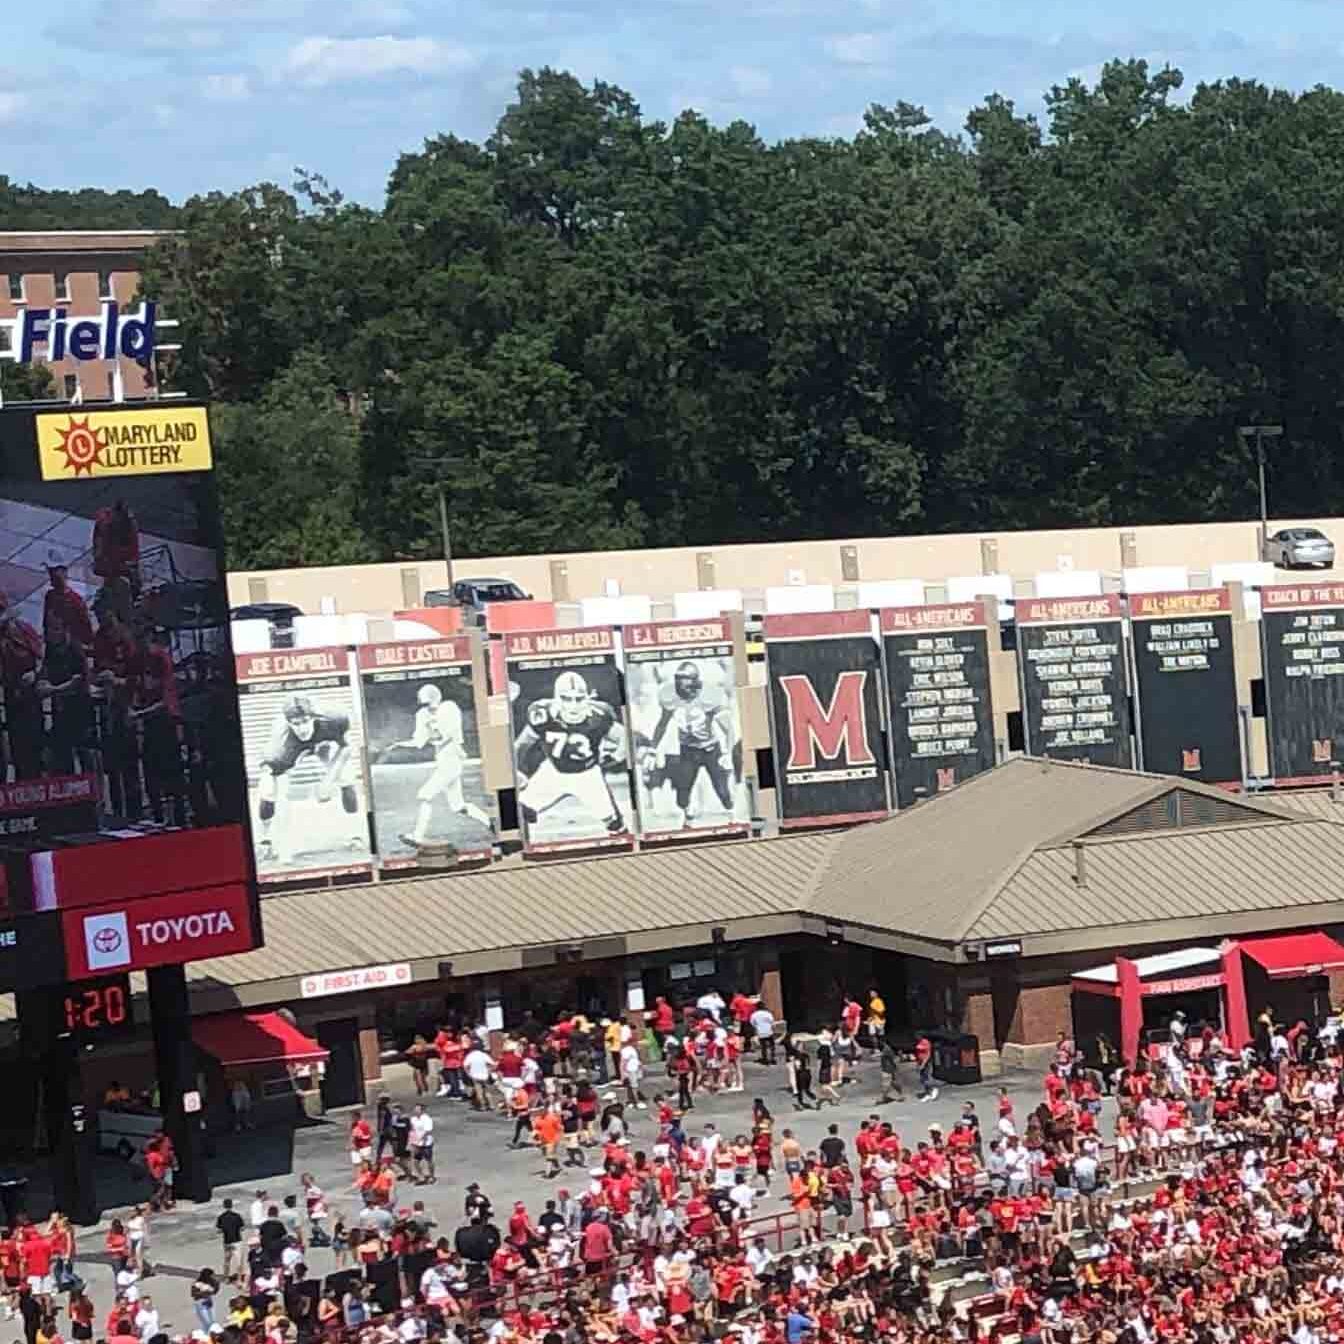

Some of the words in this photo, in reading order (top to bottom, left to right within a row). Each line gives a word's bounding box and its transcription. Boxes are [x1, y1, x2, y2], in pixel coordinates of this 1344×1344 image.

[16, 301, 157, 363] Field
[103, 422, 197, 445] MARYLAND
[106, 444, 182, 468] LOTTERY
[780, 671, 878, 770] M
[545, 731, 593, 760] 73
[136, 910, 235, 946] TOYOTA
[64, 985, 125, 1028] 1:20
